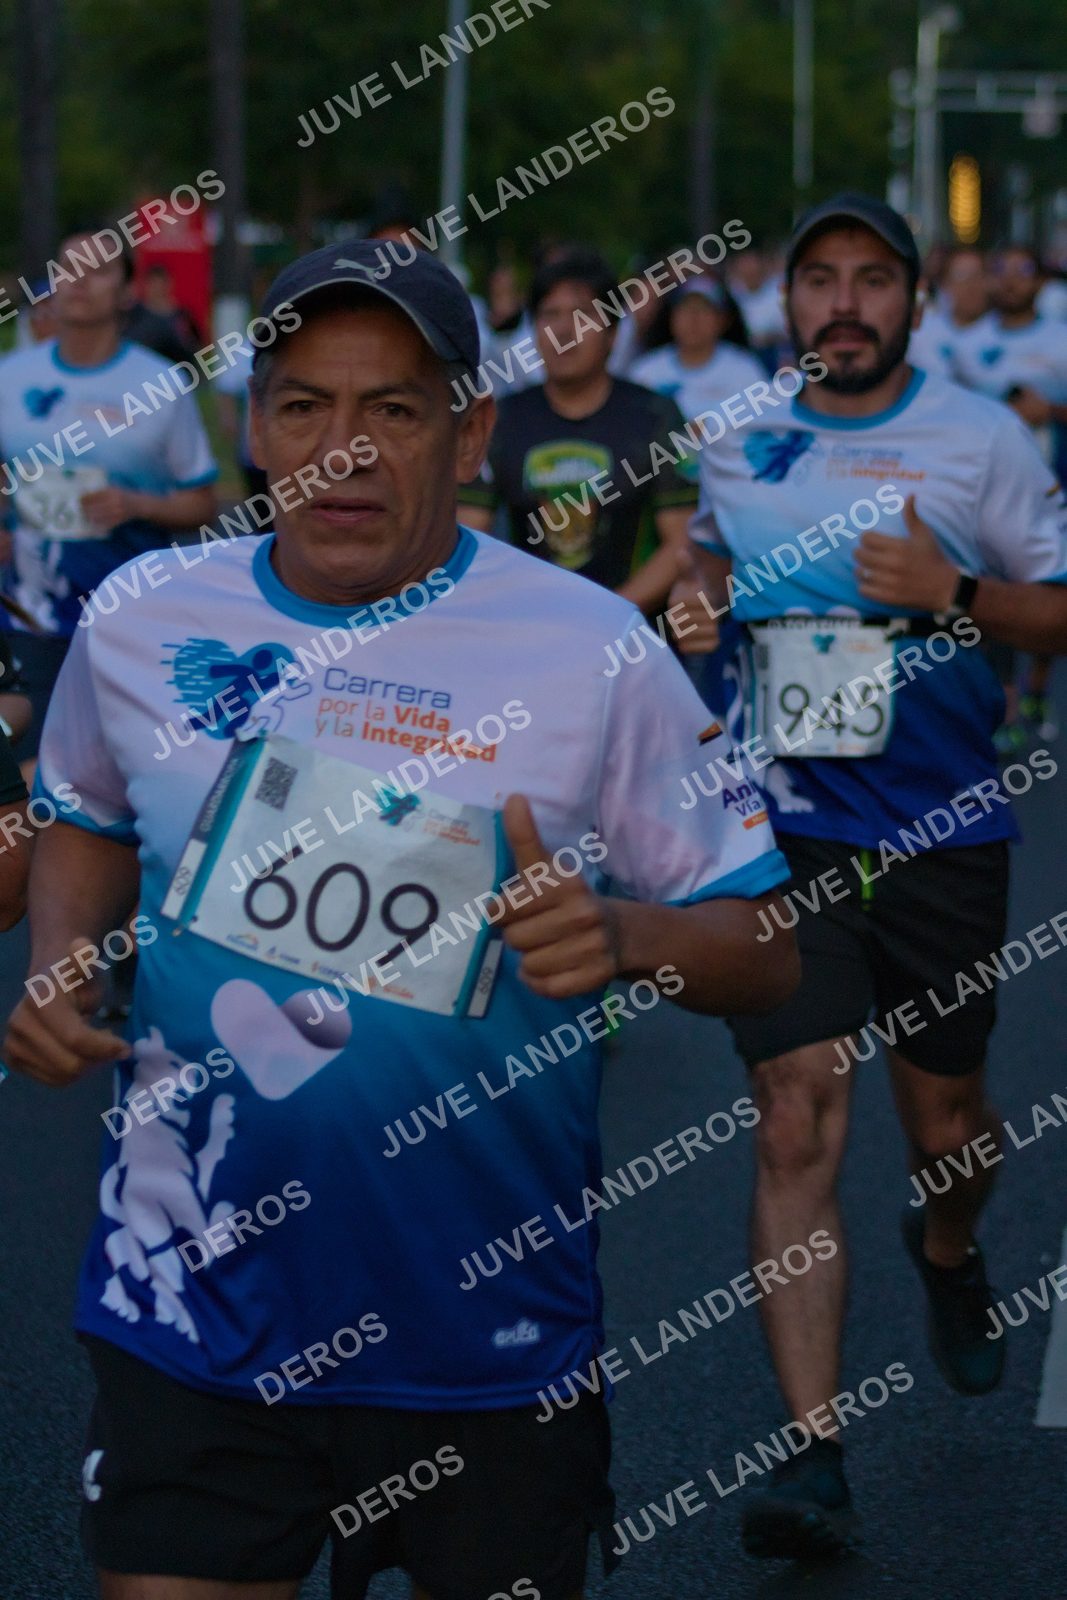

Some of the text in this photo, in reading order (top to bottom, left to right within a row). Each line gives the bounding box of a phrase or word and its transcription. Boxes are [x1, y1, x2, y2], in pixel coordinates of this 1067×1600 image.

[323, 667, 452, 709] Carrera
[317, 697, 450, 732] por la Vida
[315, 716, 497, 763] y la Integridad
[244, 845, 439, 967] 609
